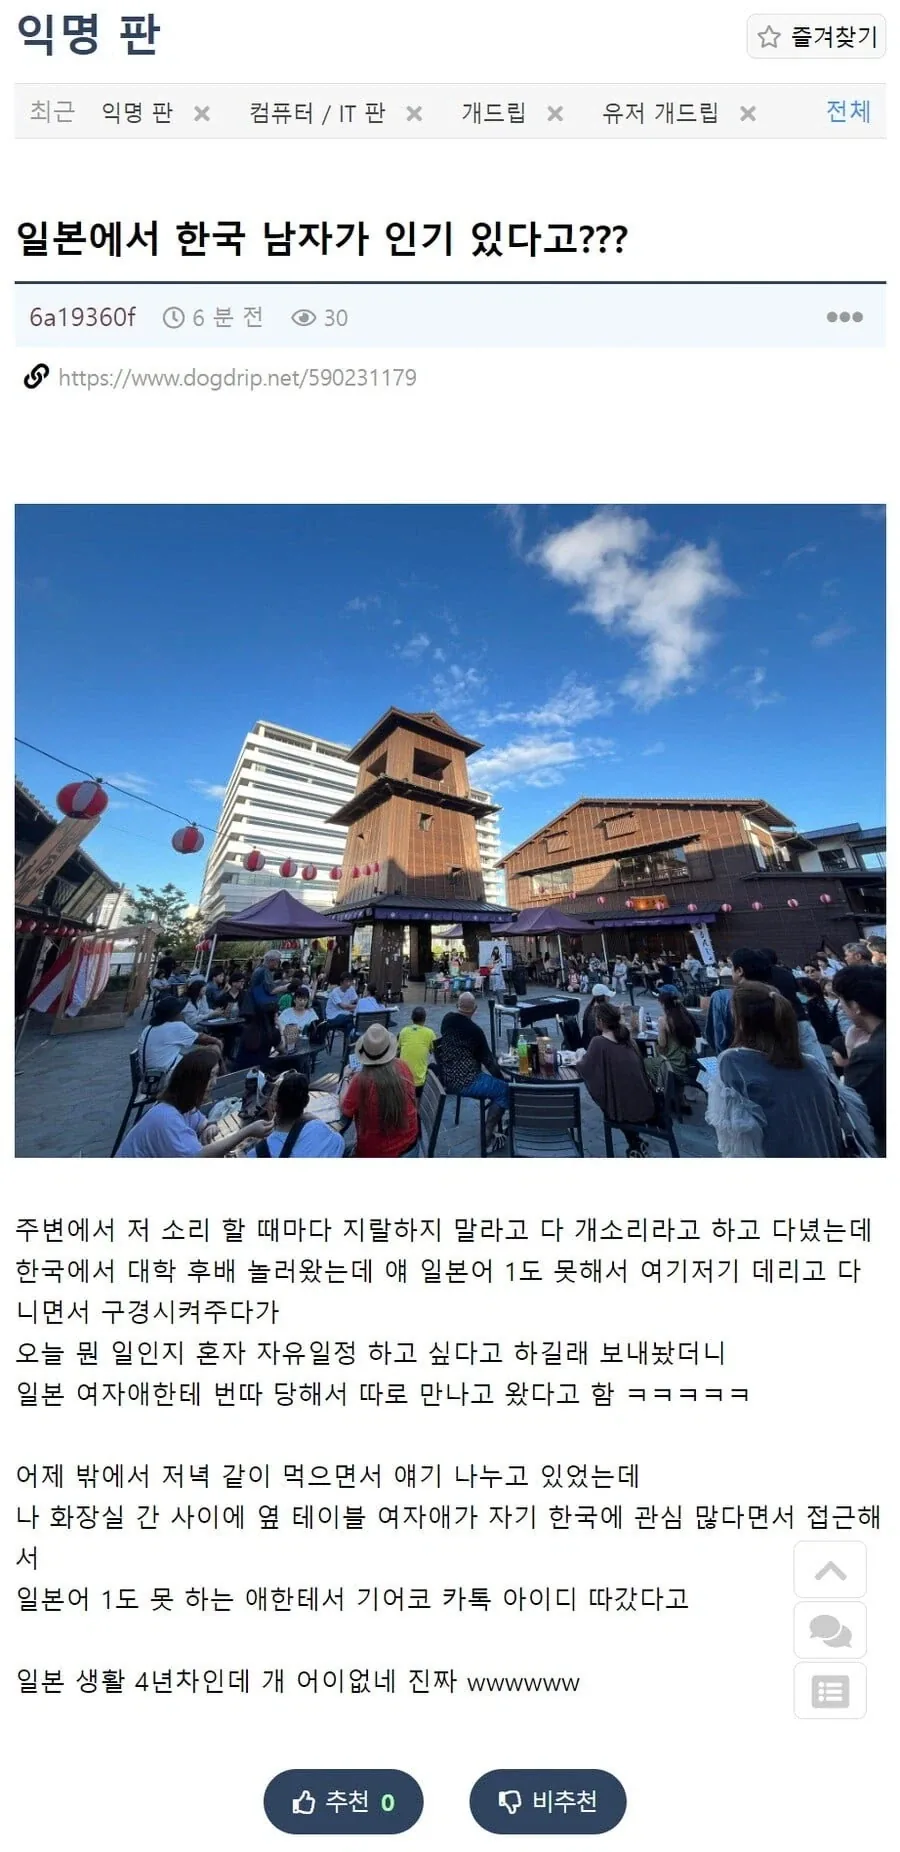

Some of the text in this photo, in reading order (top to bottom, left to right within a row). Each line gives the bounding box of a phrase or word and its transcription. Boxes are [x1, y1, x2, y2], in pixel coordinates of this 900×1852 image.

[18, 13, 160, 56] 익명 판
[792, 26, 876, 48] 즐겨찾기
[31, 100, 75, 123] 최근
[103, 102, 173, 124] 익명 판
[250, 102, 312, 124] 컴퓨터
[340, 105, 357, 122] IT
[365, 102, 386, 123] 판
[463, 102, 524, 124] 개드립
[603, 102, 717, 124] 유저 개드립
[828, 100, 869, 123] 전체
[18, 220, 628, 257] 일본에서 한국 남자가 인기 있다고???
[30, 306, 136, 326] 6a19360f
[193, 307, 262, 327] 6 분 전
[325, 309, 347, 326] 30
[60, 368, 416, 391] https://www.dogdrip.net/590231179
[16, 1218, 870, 1242] 주변에서 저 소리 할 때마다 지랄하지 말라고 다 개소리라고 하고 다녔는데
[16, 1259, 861, 1283] 한국에서 대학 후배 놀러왔는데 얘 일본어 1도 못해서 여기저기 데리고 다
[18, 1300, 279, 1324] 니면서 구경시켜주다가
[16, 1341, 723, 1365] 오늘 뭔 일인지 혼자 자유일정 하고 싶다고 하길래 보내놨더니
[18, 1382, 64, 1406] 일본
[78, 1382, 200, 1406] 여자애한테
[216, 1382, 263, 1406] 번따
[275, 1382, 345, 1406] 당해서
[360, 1382, 408, 1406] 따로
[421, 1382, 494, 1406] 만나고
[505, 1382, 579, 1406] 왔다고
[592, 1382, 614, 1406] 함
[17, 1464, 638, 1488] 어제 밖에서 저녁 같이 먹으면서 얘기 나누고 있었는데
[17, 1505, 879, 1529] 나 화장실 간 사이에 옆 테이블 여자애가 자기 한국에 관심 많다면서 접근해
[16, 1546, 36, 1570] 서
[18, 1587, 688, 1611] 일본어 1도 못 하는 애한테서 기어코 카톡 아이디 따갔다고
[18, 1669, 580, 1693] 일본 생활 4년차인데 개 어이없네 진짜 wwwwww
[326, 1790, 395, 1813] 추천 0
[534, 1790, 596, 1813] 비추천
